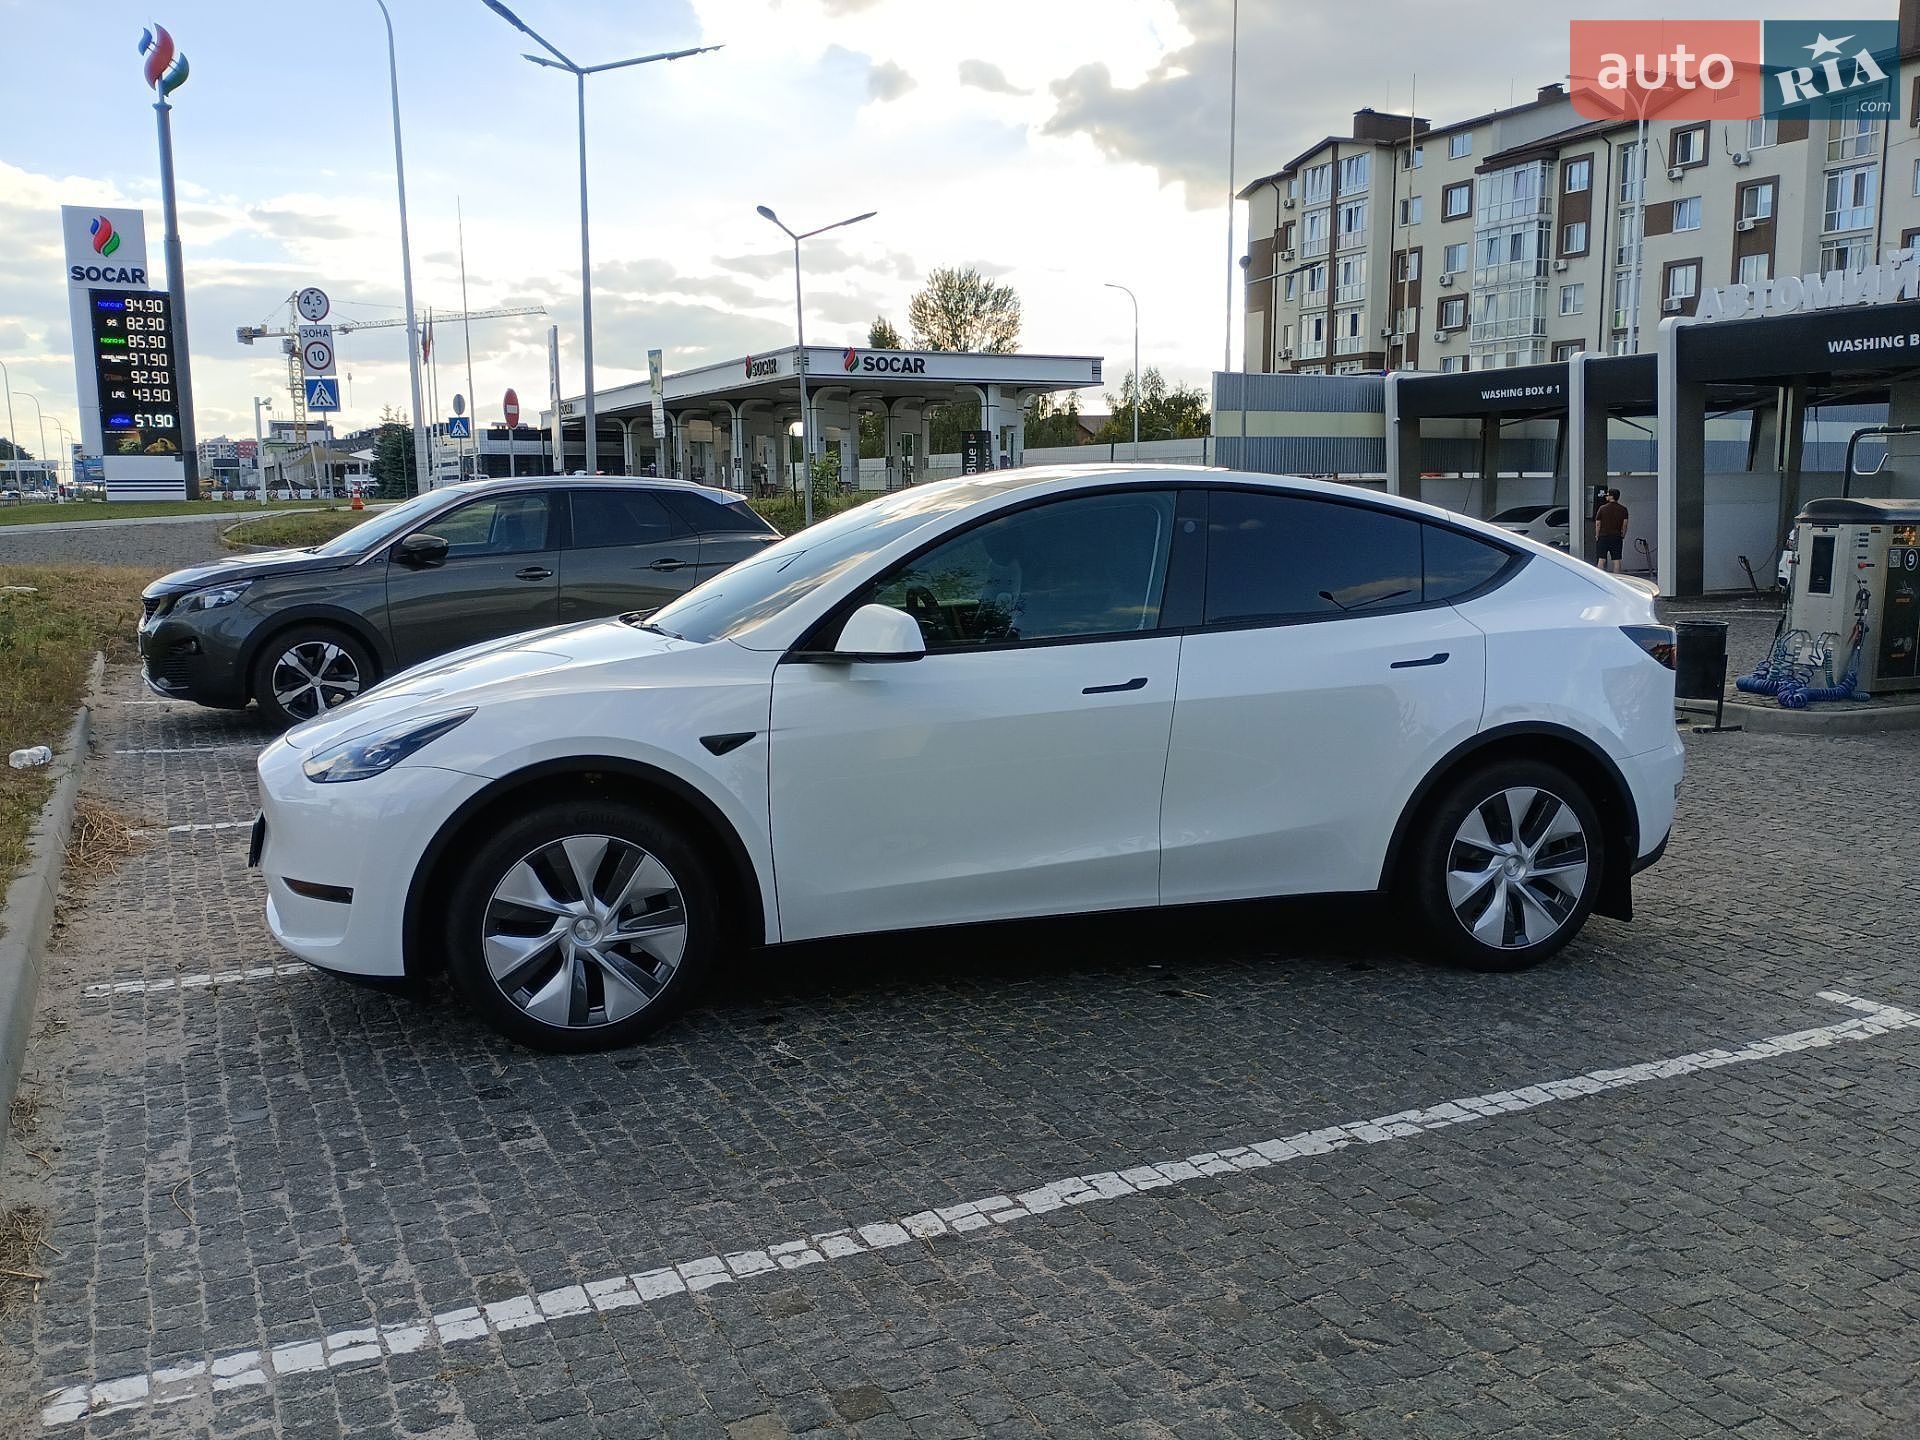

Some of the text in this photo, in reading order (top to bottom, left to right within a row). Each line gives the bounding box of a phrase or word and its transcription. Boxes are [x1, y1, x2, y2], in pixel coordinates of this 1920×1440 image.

[71, 265, 145, 284] SOCAR
[124, 298, 164, 313] 94.90
[126, 316, 165, 331] 82.90
[302, 329, 329, 338] ЗОНА
[127, 334, 166, 349] 85.90
[1827, 334, 1905, 354] WASHING
[129, 352, 168, 367] 97.90
[311, 350, 325, 361] 10
[863, 355, 926, 374] SOCAR
[131, 370, 169, 385] 92.90
[111, 389, 171, 402] LPG 43.90
[1481, 388, 1523, 400] WASHING
[1525, 385, 1545, 396] BOX
[1555, 384, 1560, 394] 1
[134, 414, 174, 428] 57.90
[1907, 553, 1915, 566] 9
